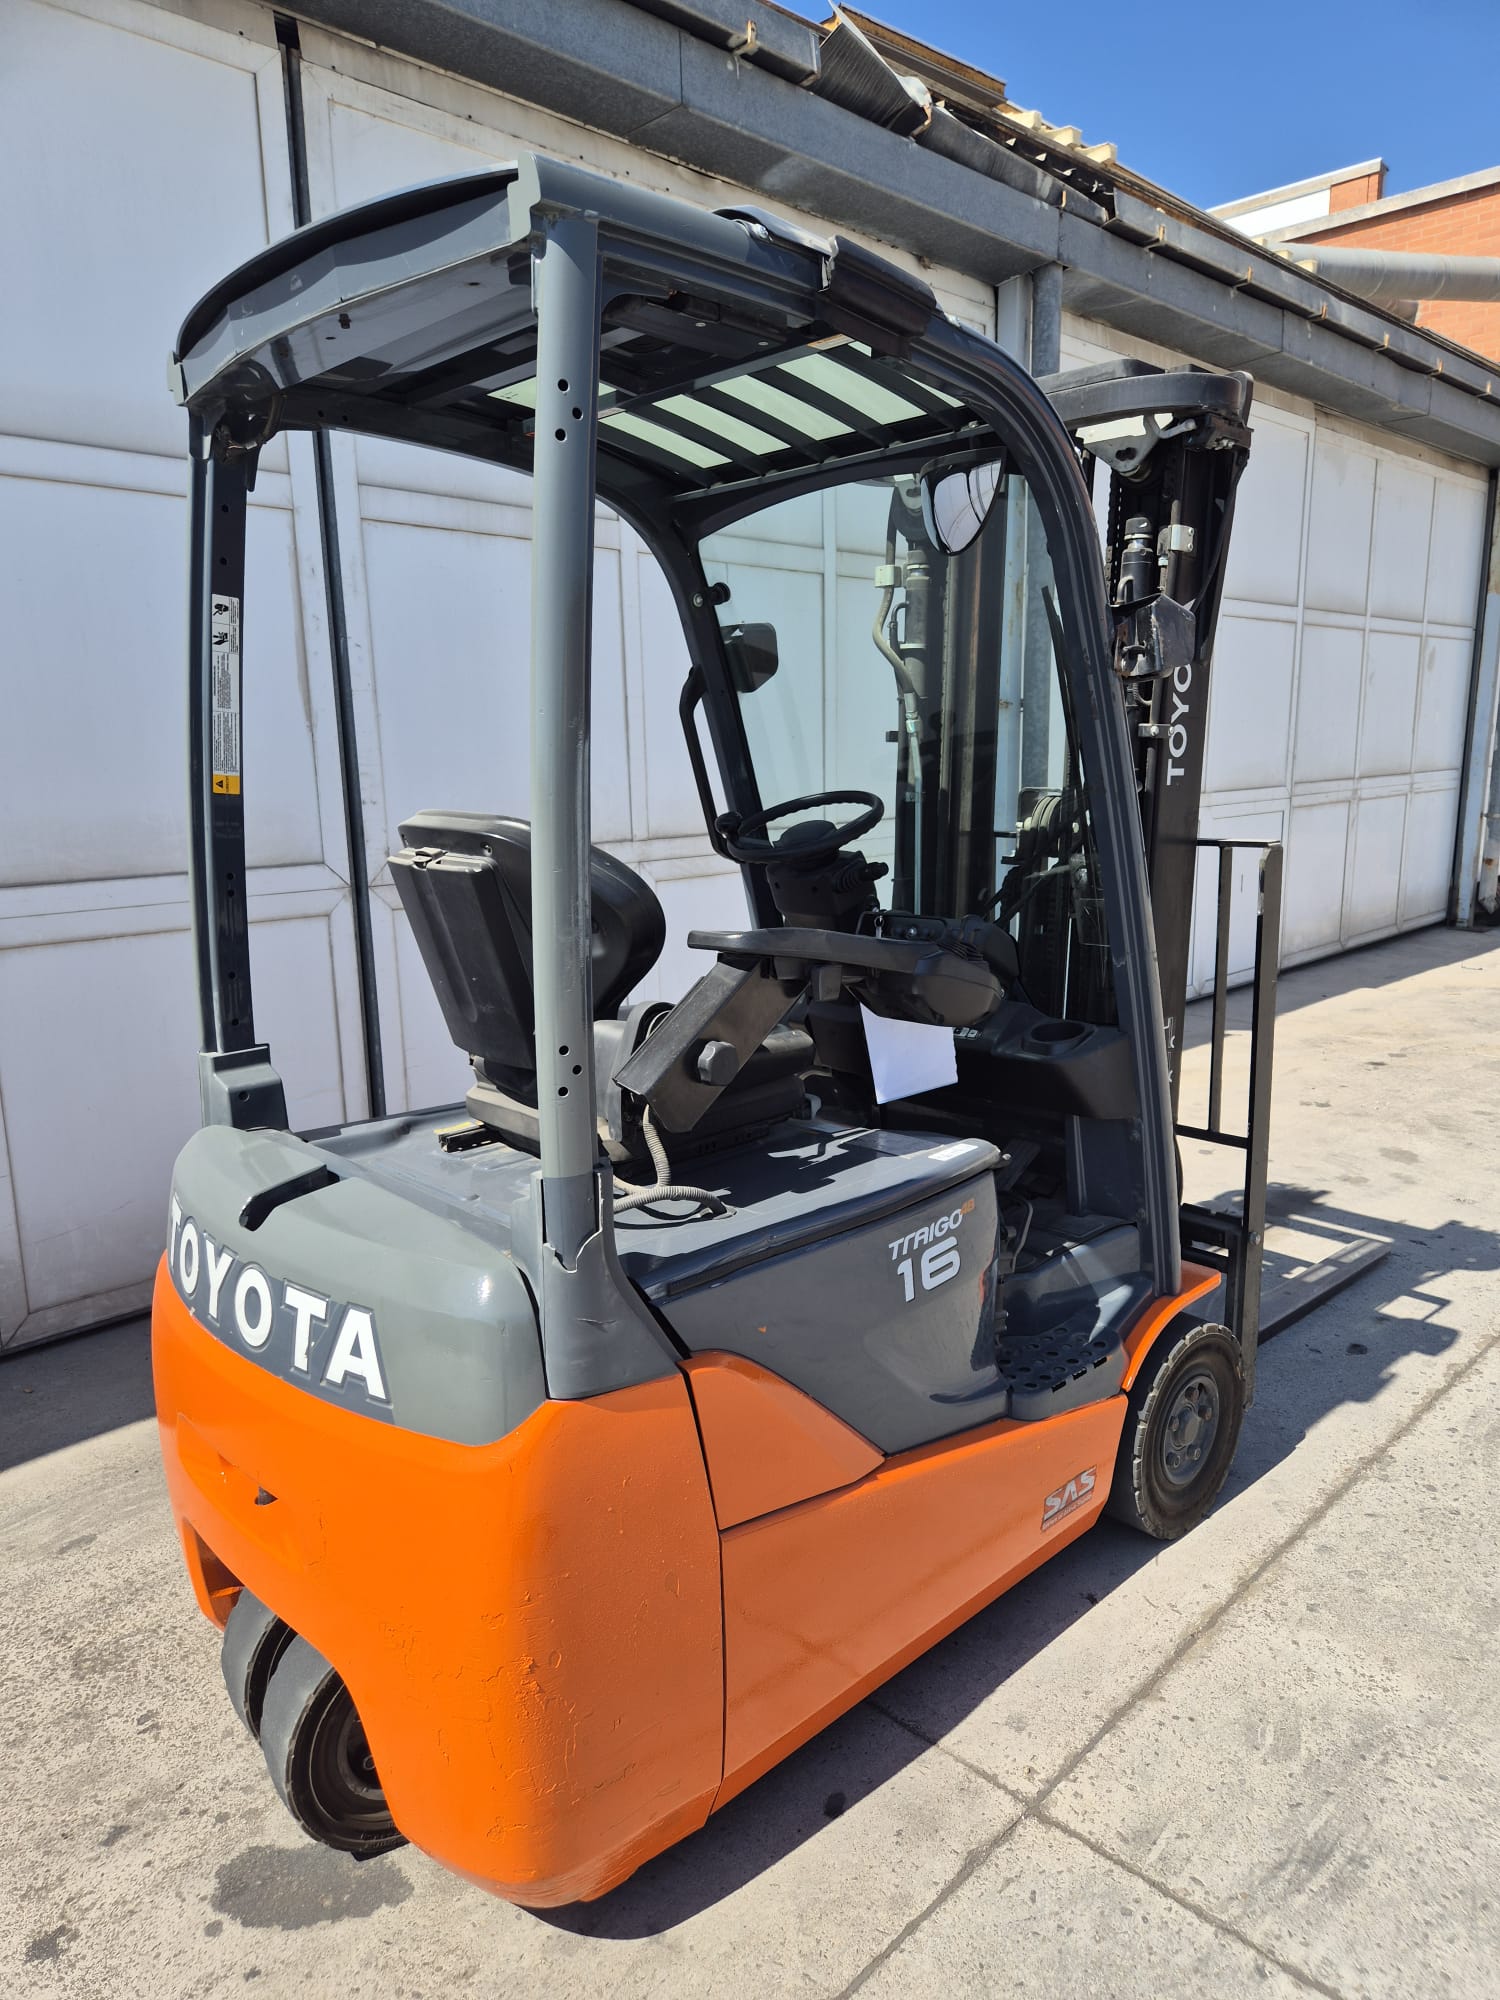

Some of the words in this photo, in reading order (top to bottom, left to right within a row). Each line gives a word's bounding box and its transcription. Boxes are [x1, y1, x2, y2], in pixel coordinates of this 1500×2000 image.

[1166, 598, 1195, 786] TOYO
[170, 1197, 387, 1400] TOYOTA
[896, 1236, 961, 1303] 16
[1044, 1465, 1097, 1521] SAS
